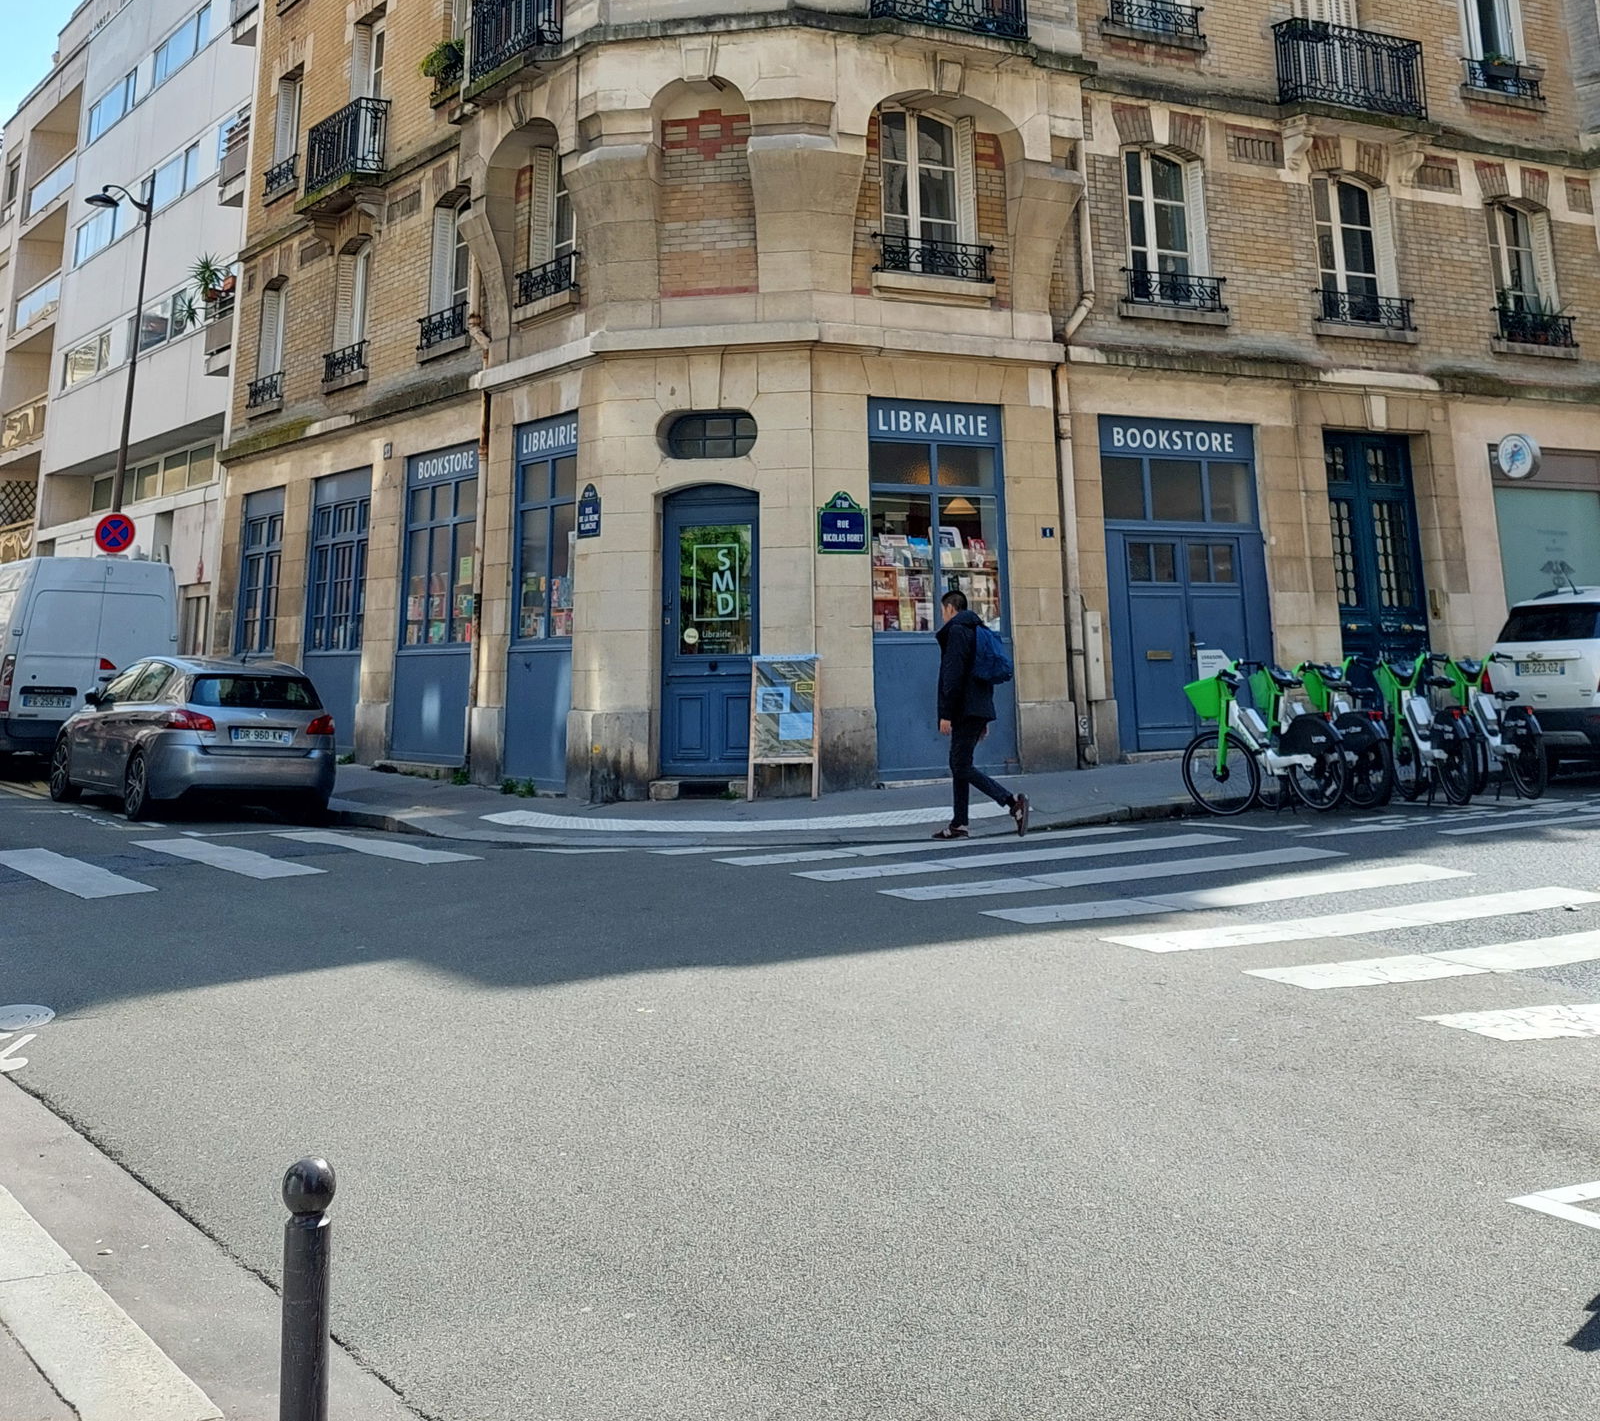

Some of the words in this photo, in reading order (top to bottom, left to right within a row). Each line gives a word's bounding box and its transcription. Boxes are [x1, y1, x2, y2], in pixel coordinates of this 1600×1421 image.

[878, 409, 988, 437] LIBRAIRIE
[522, 423, 577, 453] LIBRAIRIE
[1112, 427, 1234, 453] BOOKSTORE
[418, 450, 474, 479] BOOKSTORE
[822, 533, 846, 542] NICOLAS
[836, 519, 850, 529] RUE
